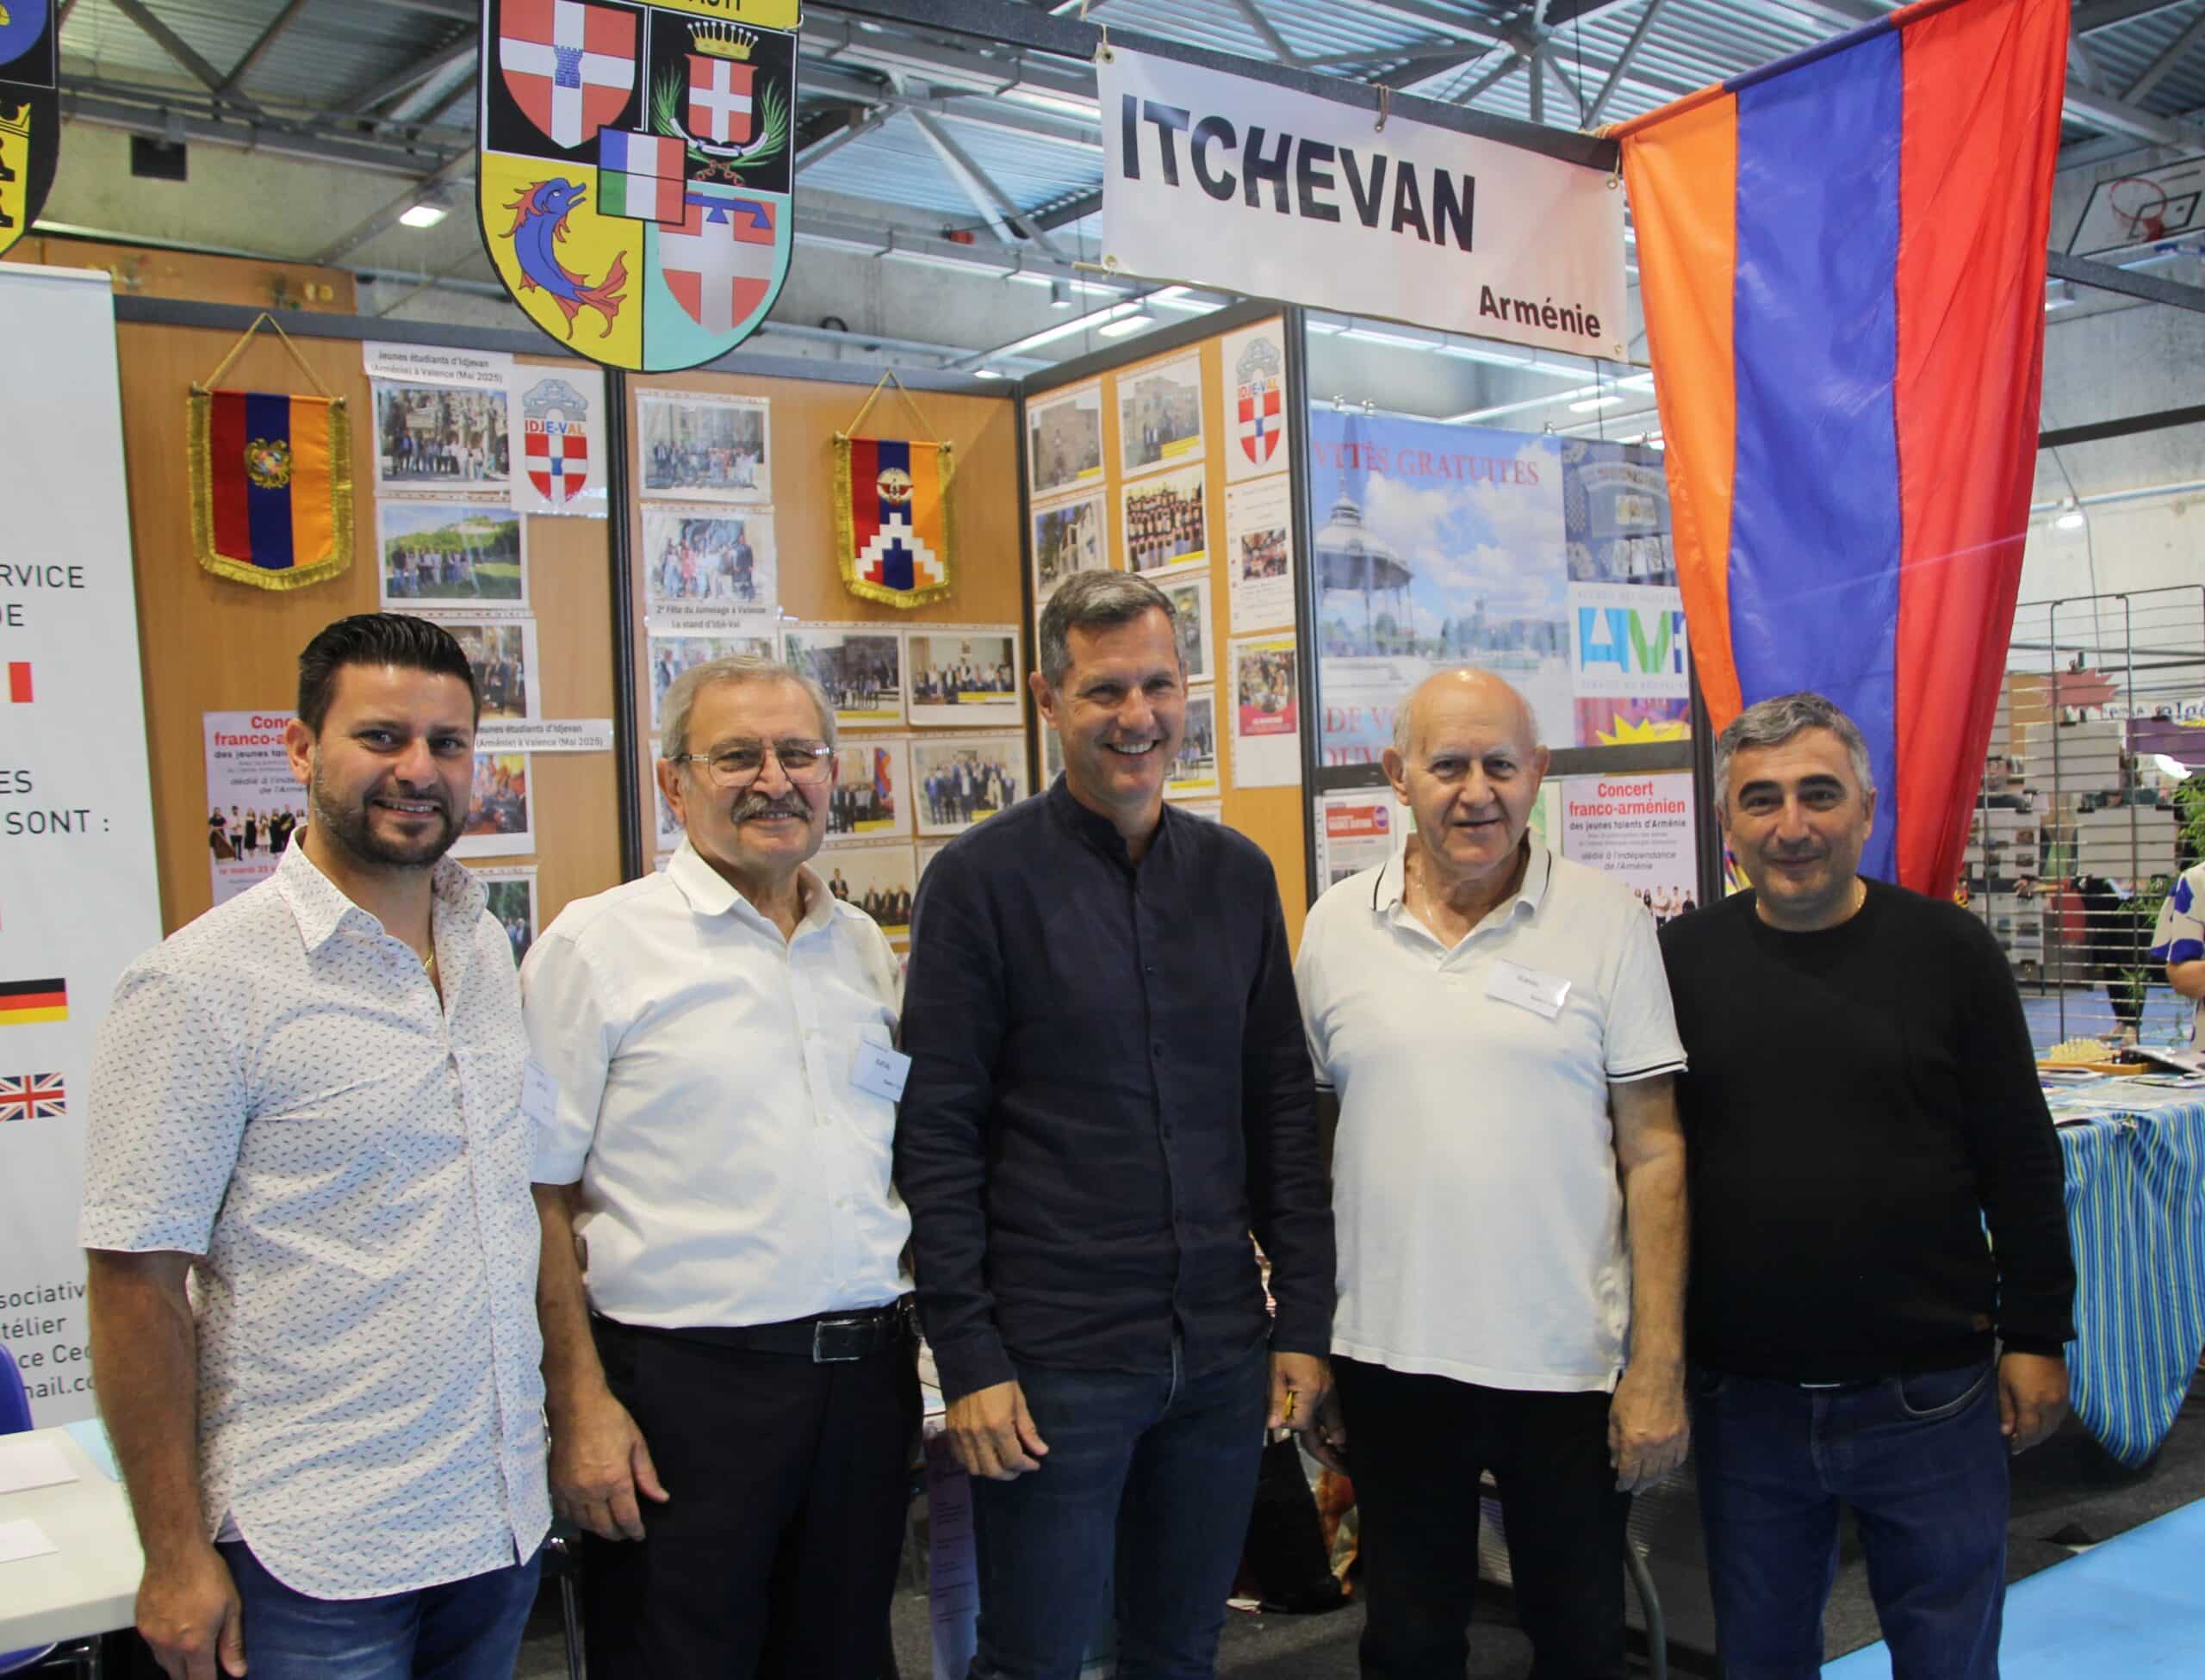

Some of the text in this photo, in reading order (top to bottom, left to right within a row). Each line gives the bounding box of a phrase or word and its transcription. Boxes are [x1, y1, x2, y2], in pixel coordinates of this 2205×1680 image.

[1121, 94, 1476, 253] ITCHEVAN
[1479, 285, 1601, 338] Arménie
[1396, 448, 1540, 487] GRATUITES
[0, 564, 85, 588] RVICE
[0, 604, 24, 626] E
[1324, 706, 1365, 733] DE
[1598, 781, 1655, 797] Concert
[1568, 797, 1686, 817] franco-arménien
[6, 810, 90, 835] SONT
[1569, 821, 1584, 830] des
[1585, 821, 1612, 832] jeunes
[2, 1317, 67, 1339] télier
